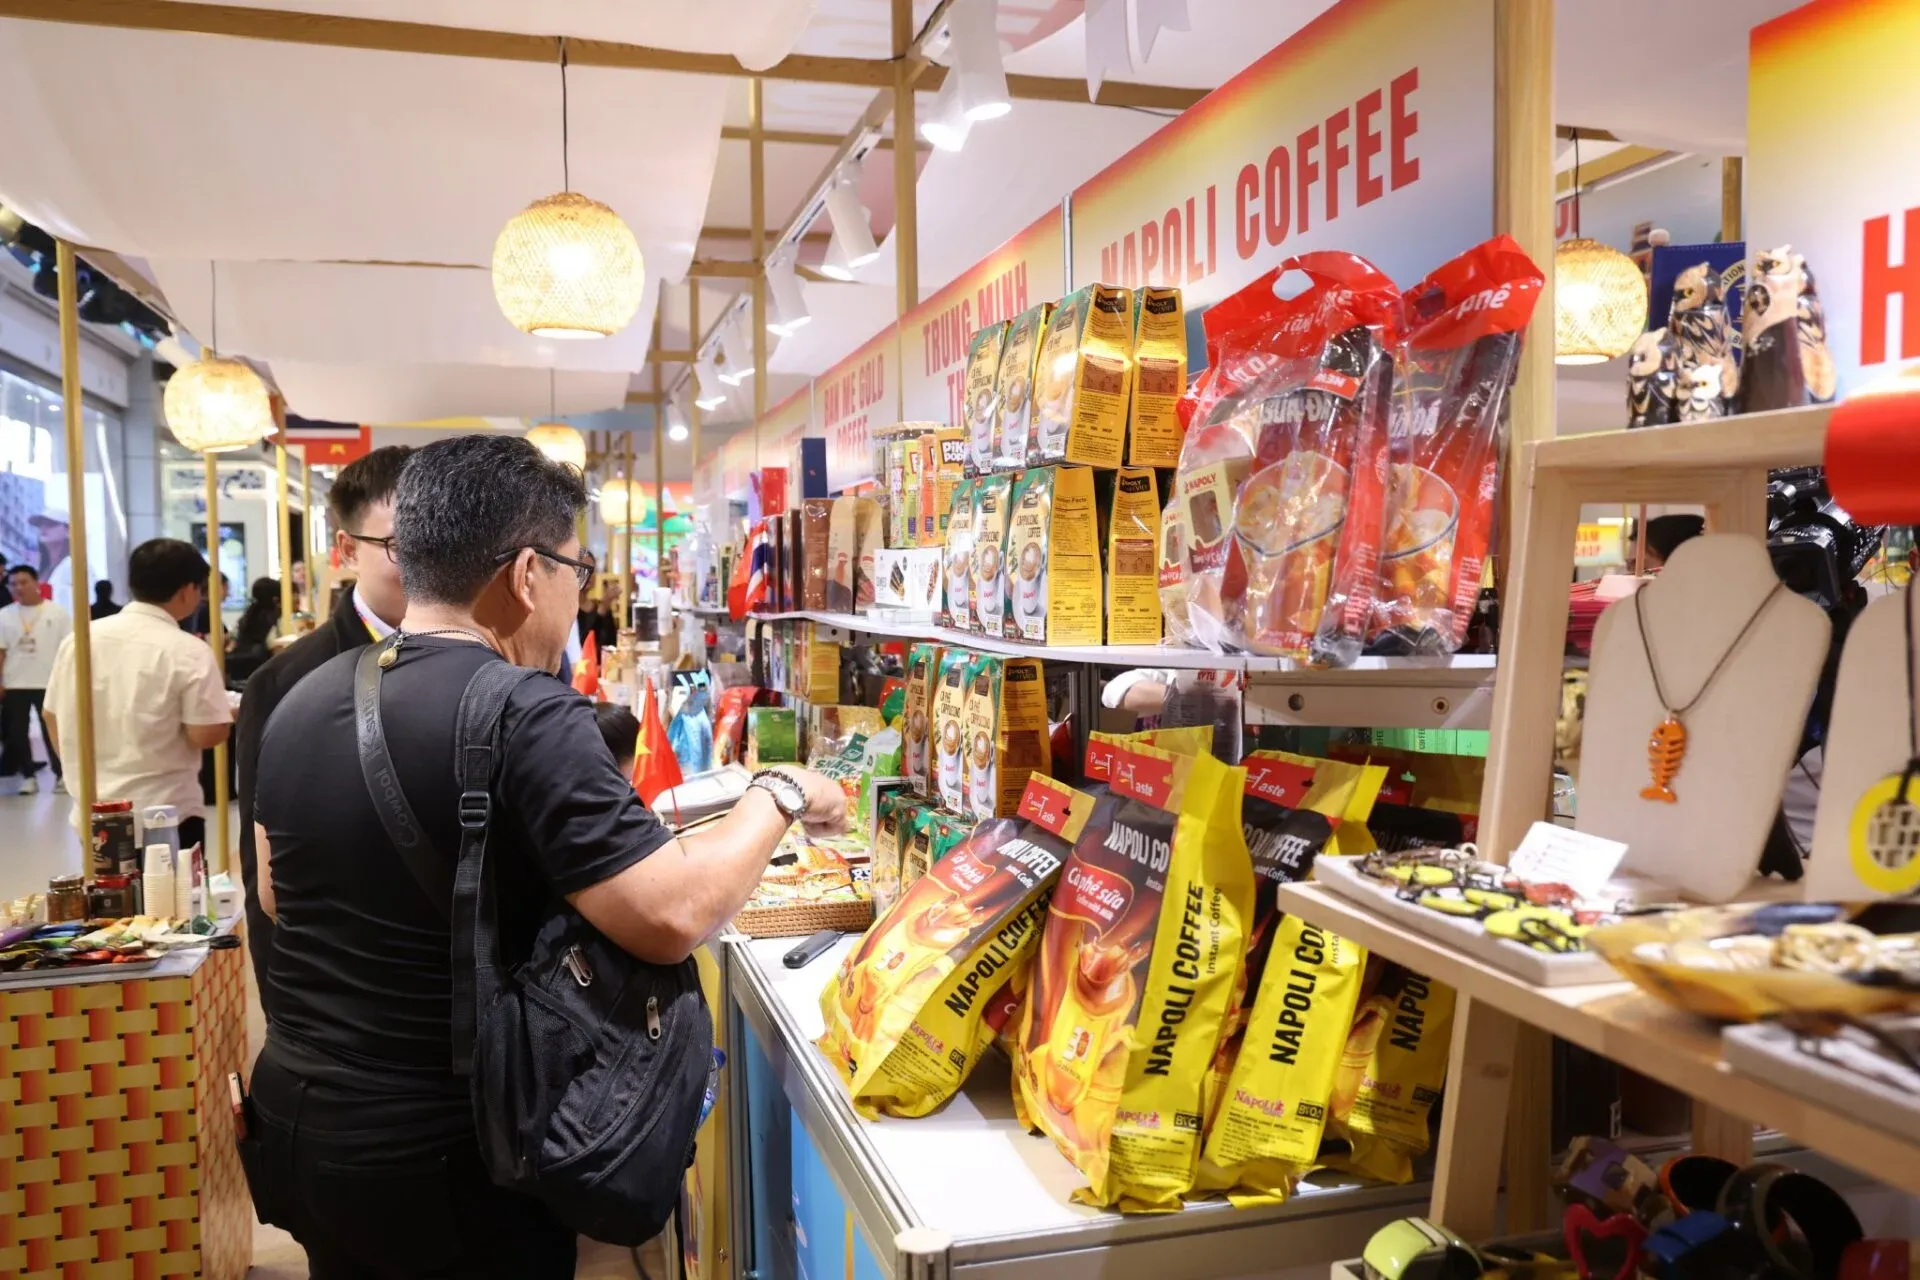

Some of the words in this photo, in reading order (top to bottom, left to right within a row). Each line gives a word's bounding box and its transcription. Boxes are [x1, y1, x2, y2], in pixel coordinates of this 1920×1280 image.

[1101, 184, 1217, 291] NAPOLI
[1236, 66, 1420, 261] COFFEE
[923, 297, 971, 377] TRUNG
[978, 261, 1028, 327] MINH
[858, 353, 884, 410] GOLD
[1103, 820, 1151, 867] NAPOLI
[1208, 887, 1222, 928] Coffee
[944, 943, 1010, 1018] NAPOLI
[1143, 985, 1195, 1077] NAPOLI
[1172, 880, 1204, 980] COFFEE
[1206, 930, 1220, 974] Instant
[1269, 968, 1317, 1065] NAPOLI
